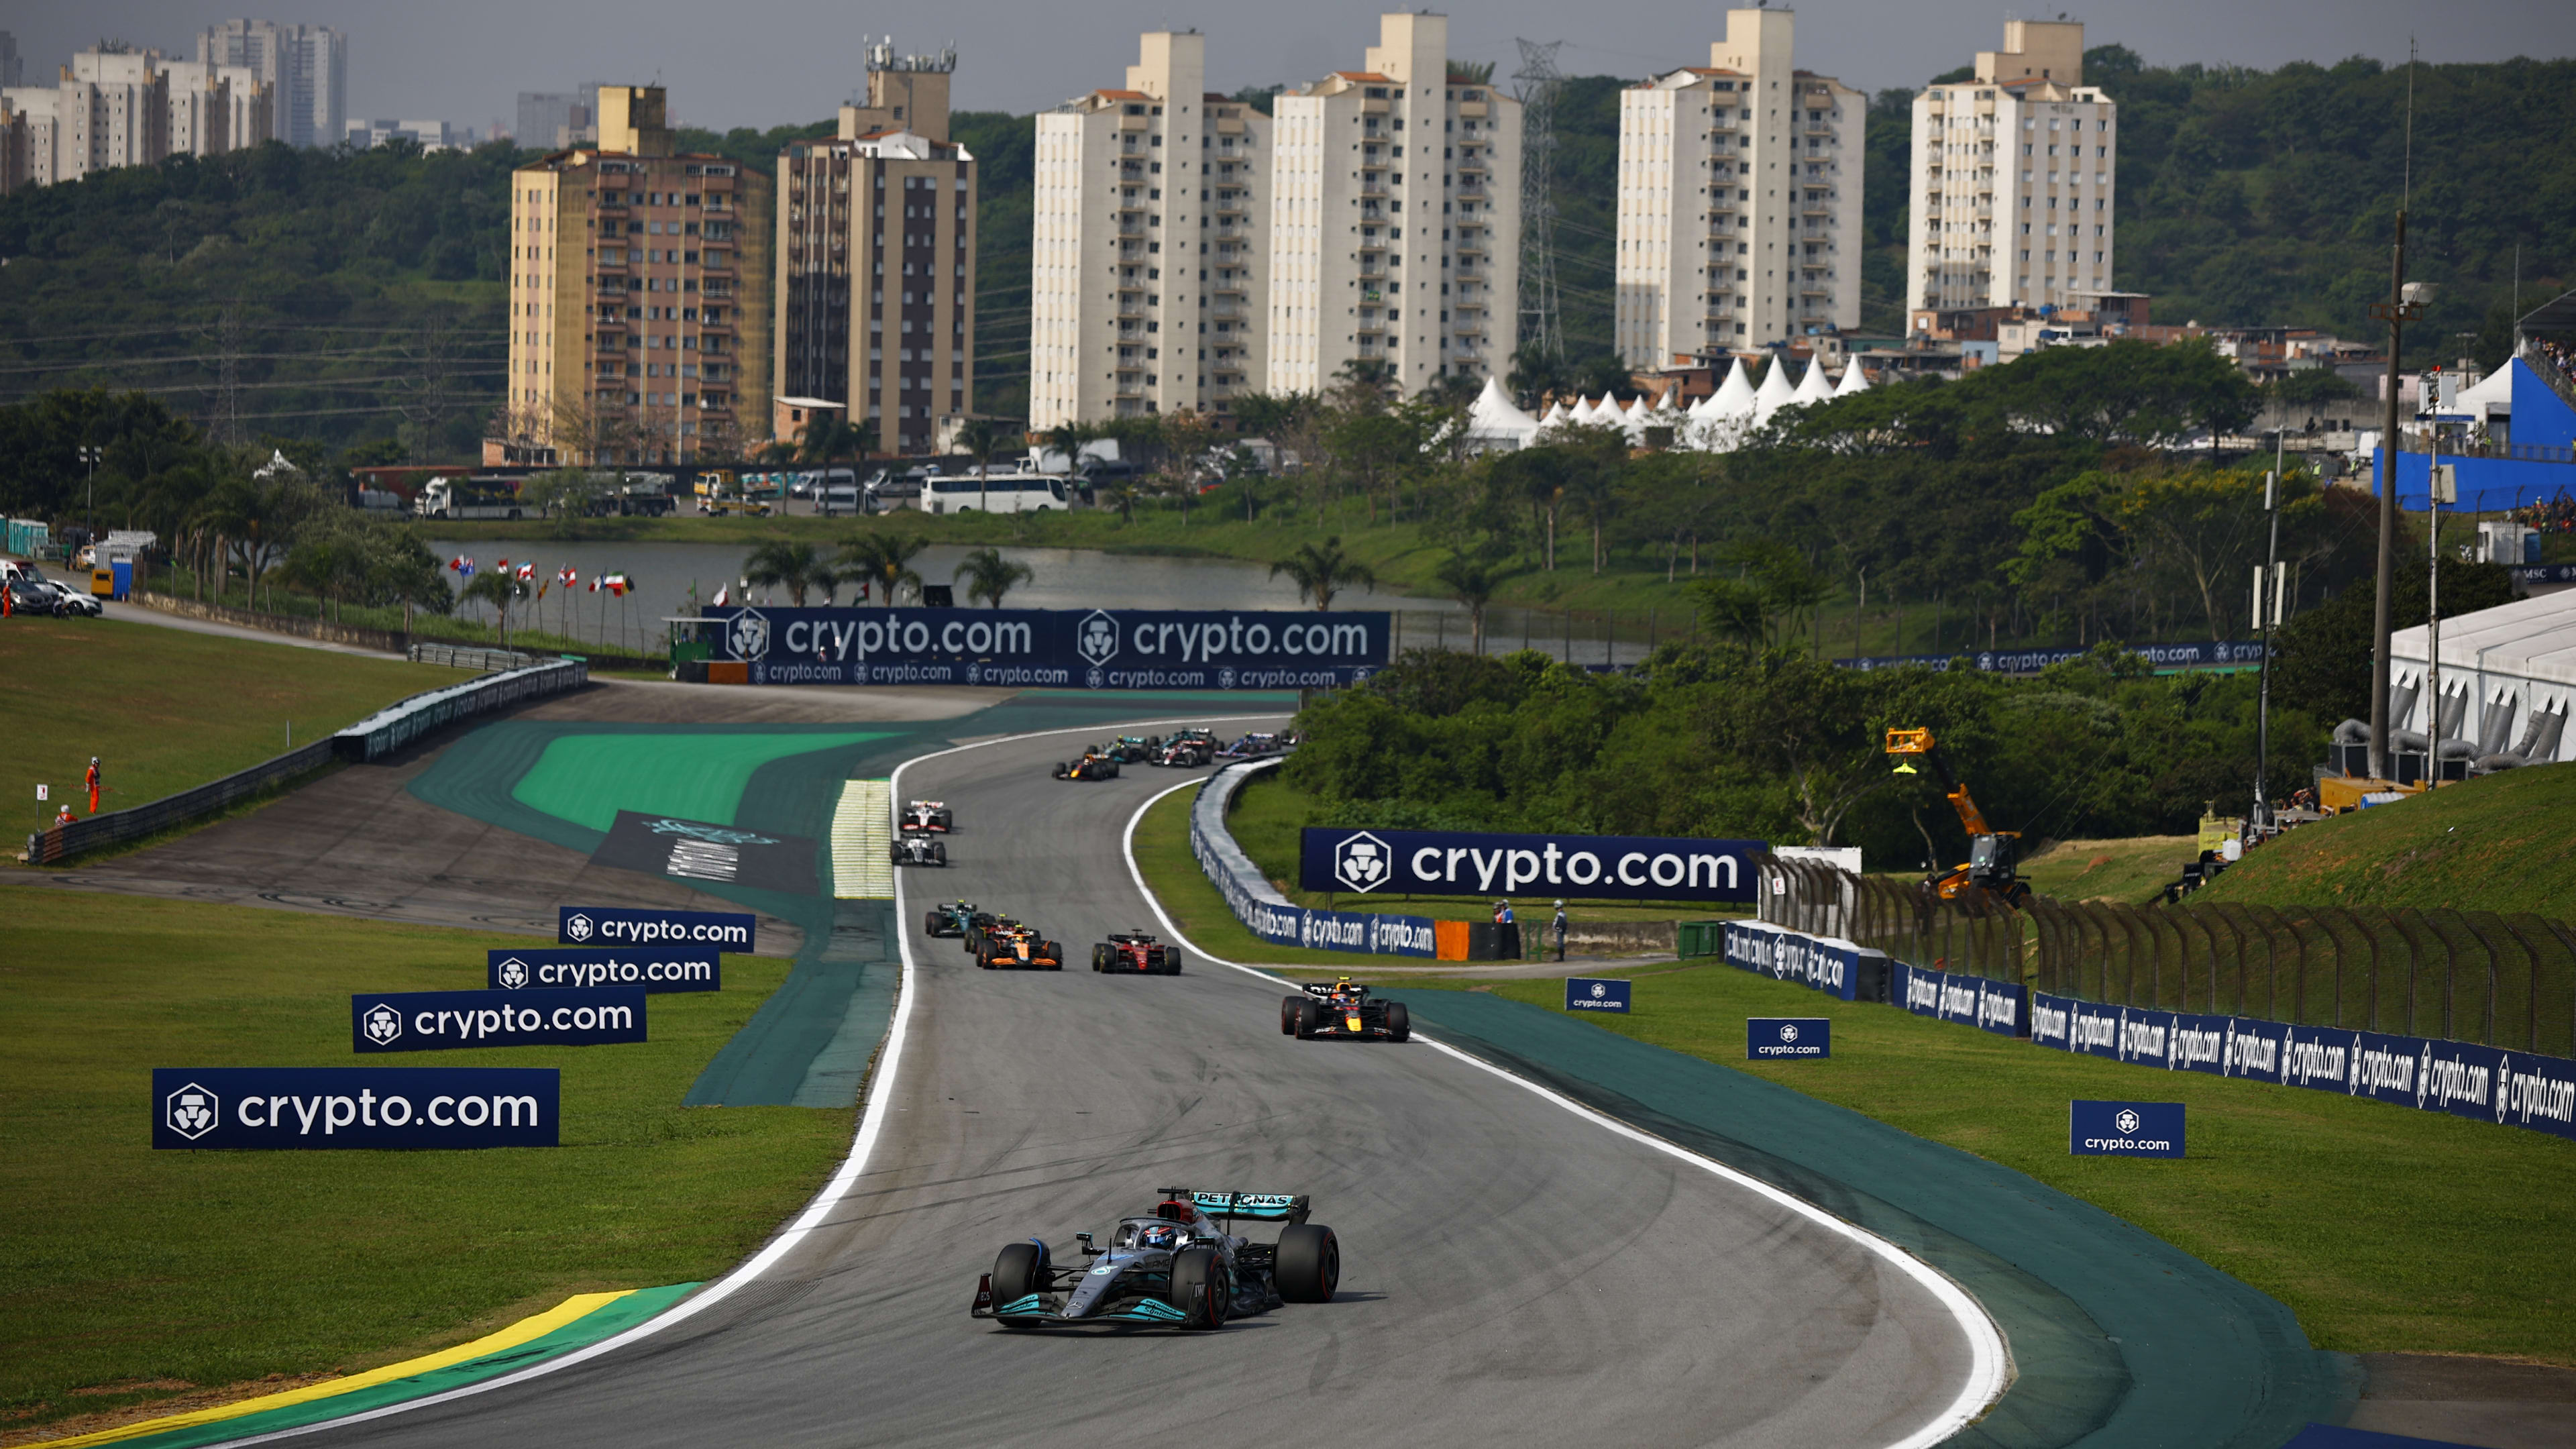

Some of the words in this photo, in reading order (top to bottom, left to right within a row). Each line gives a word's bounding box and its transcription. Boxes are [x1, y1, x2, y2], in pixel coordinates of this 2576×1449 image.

[786, 614, 1031, 661] crypto.com
[1134, 615, 1367, 663] crypto.com
[770, 663, 841, 683] crypto.com
[873, 663, 951, 685] crypto.com
[984, 666, 1069, 686] crypto.com
[1108, 668, 1204, 688] crypto.com
[1240, 669, 1336, 688] crypto.com
[1411, 843, 1737, 892] crypto.com
[600, 919, 747, 943] crypto.com
[539, 959, 710, 986] crypto.com
[415, 1004, 632, 1039] crypto.com
[1573, 1000, 1622, 1008] crypto.com
[1758, 1045, 1820, 1056] crypto.com
[2078, 1010, 2115, 1052] crypto.com
[2127, 1017, 2165, 1061] crypto.com
[2178, 1023, 2220, 1069] crypto.com
[2234, 1028, 2276, 1075] crypto.com
[2292, 1036, 2345, 1085] crypto.com
[2362, 1044, 2414, 1095] crypto.com
[2430, 1053, 2489, 1108] crypto.com
[238, 1088, 538, 1135] crypto.com
[2511, 1067, 2575, 1124] crypto.com
[2085, 1137, 2170, 1151] crypto.com
